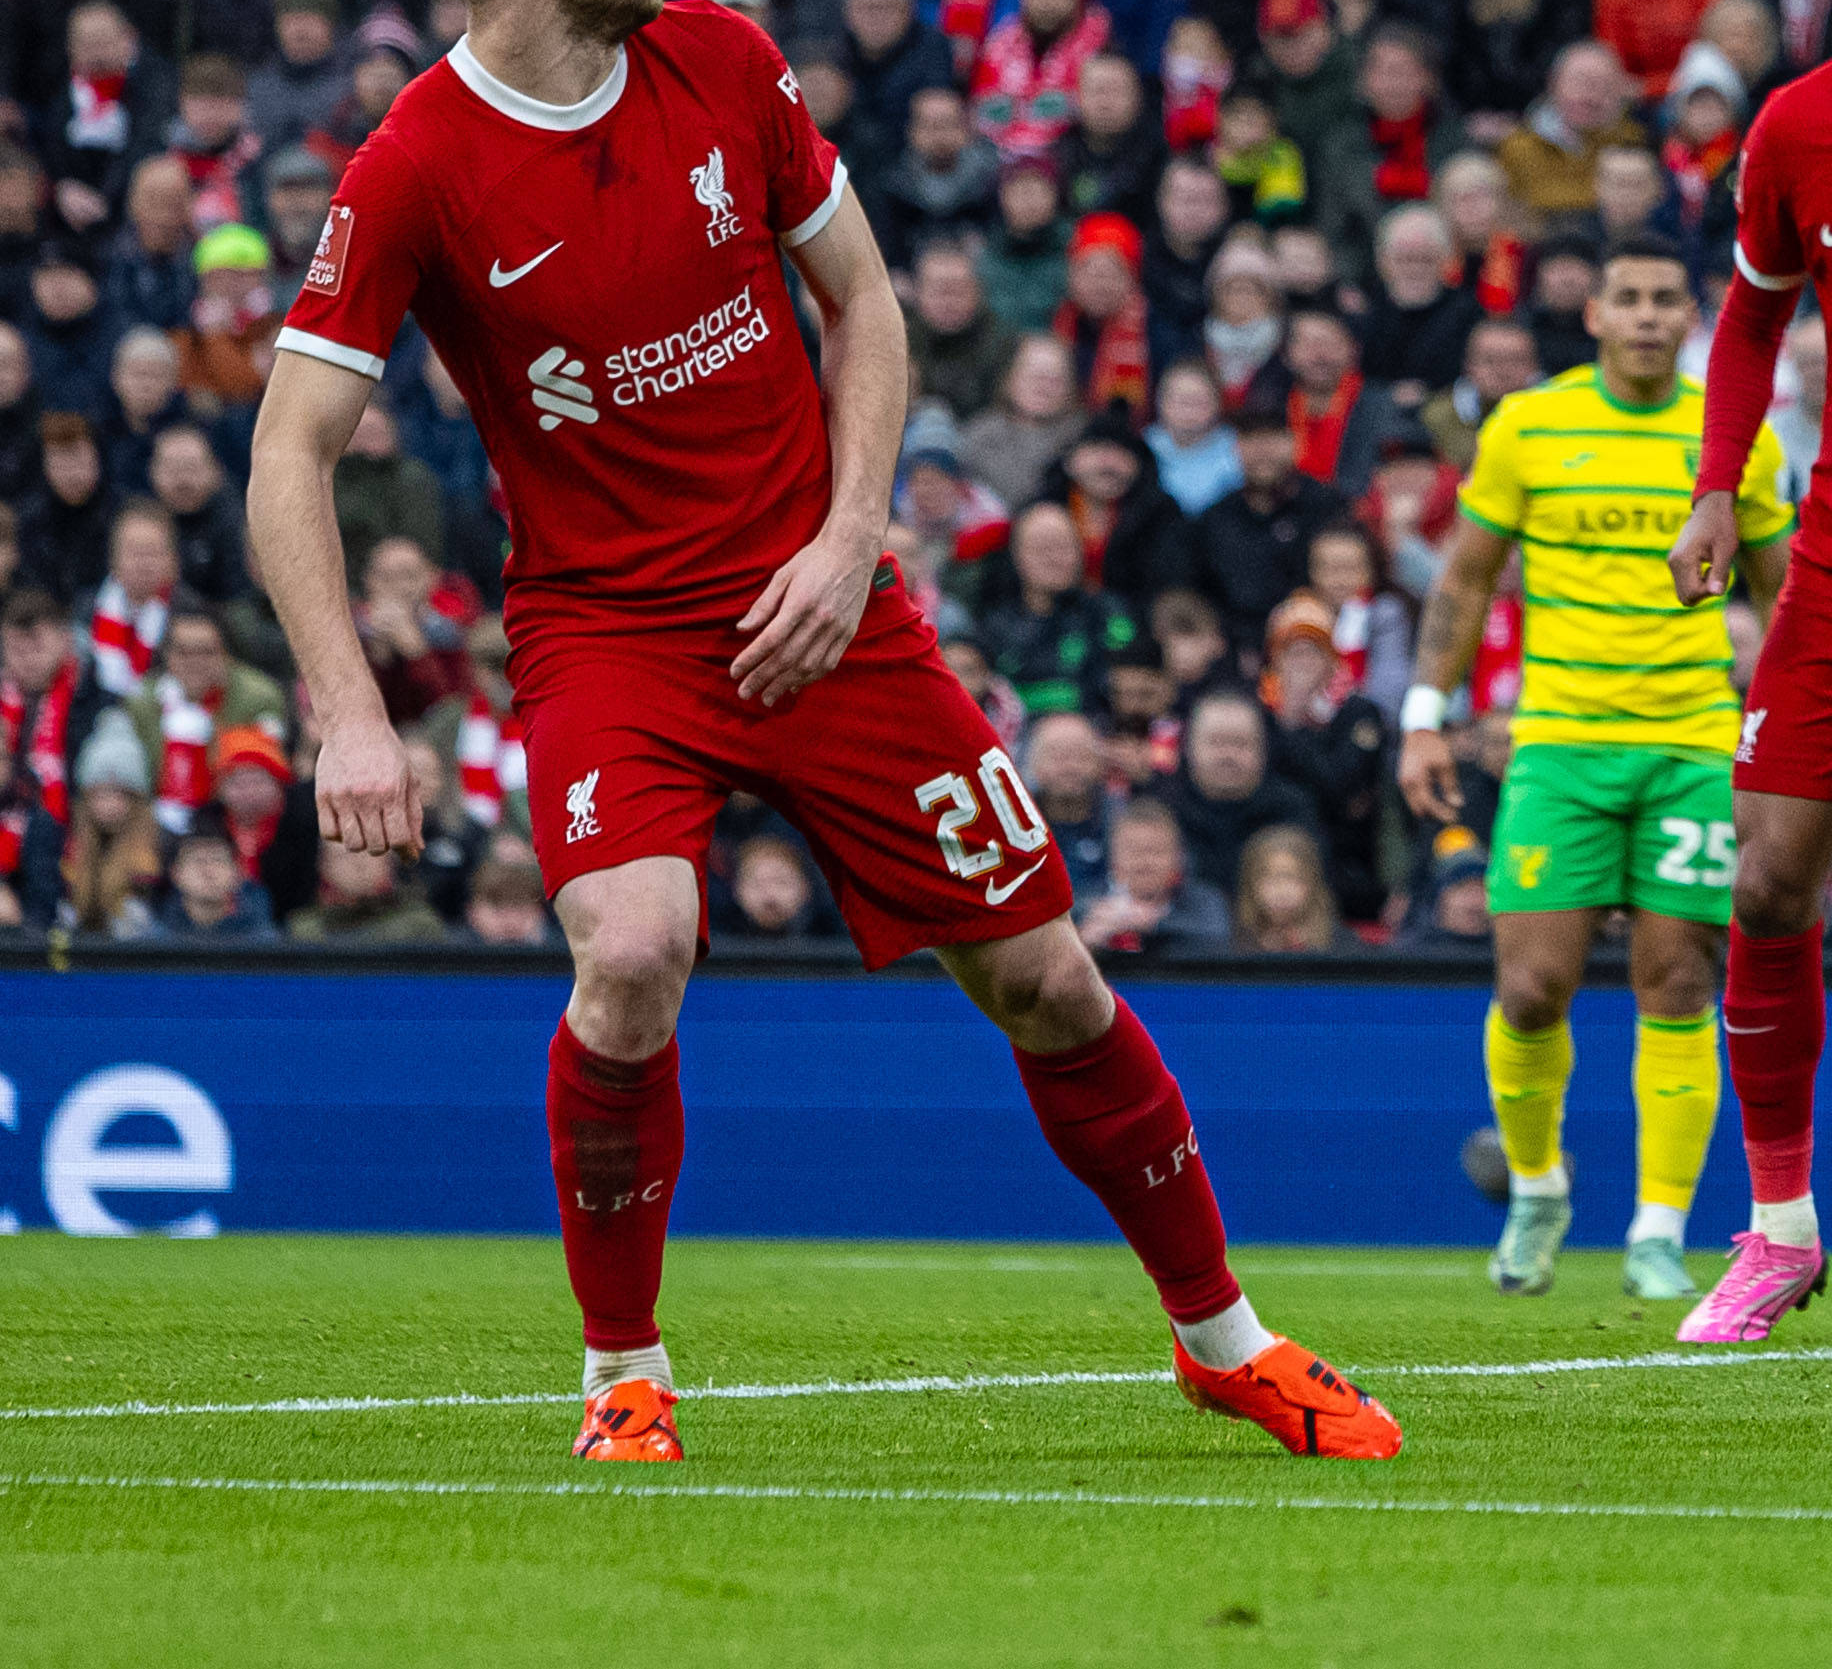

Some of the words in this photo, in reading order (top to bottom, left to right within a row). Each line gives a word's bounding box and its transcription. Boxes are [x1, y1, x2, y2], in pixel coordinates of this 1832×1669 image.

[307, 268, 335, 286] CUP
[603, 285, 753, 380] standard
[612, 308, 771, 407] chartered
[1574, 506, 1688, 536] LOTU
[914, 746, 1049, 880] 20
[1656, 817, 1736, 887] 25
[0, 1060, 234, 1239] e
